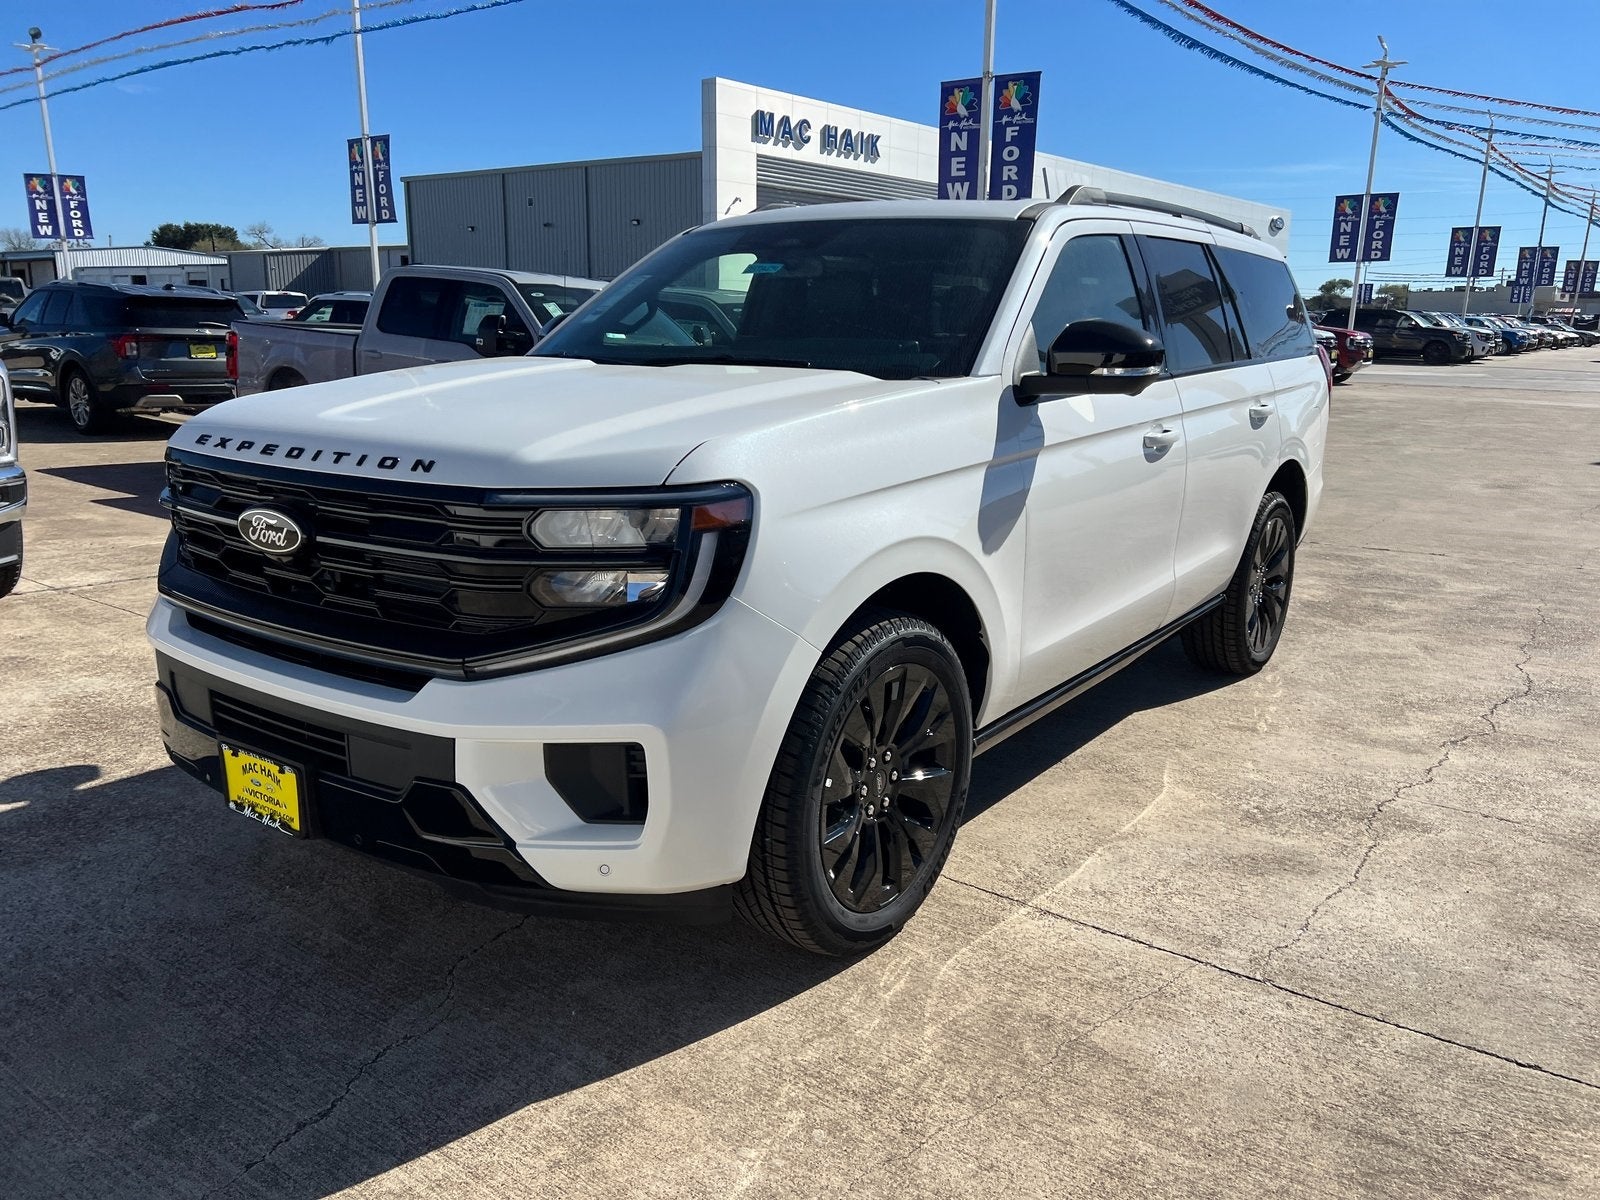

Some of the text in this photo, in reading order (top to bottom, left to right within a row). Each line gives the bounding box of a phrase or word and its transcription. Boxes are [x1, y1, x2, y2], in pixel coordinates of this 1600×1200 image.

[754, 109, 881, 162] MAC HAIK
[947, 131, 970, 200] NEW
[1001, 126, 1020, 200] FORD
[354, 171, 367, 219] NEW
[378, 171, 390, 220] FORD
[35, 199, 53, 236] NEW
[69, 200, 85, 237] FORD
[1335, 221, 1352, 259] NEW
[1370, 220, 1385, 259] FORD
[1451, 247, 1464, 275] NEW
[1478, 246, 1490, 275] FORD
[1519, 262, 1530, 285] NEW
[1541, 262, 1551, 285] FORD
[1565, 272, 1575, 292] NEW
[1583, 273, 1592, 292] FORD
[195, 433, 437, 473] EXPEDITION
[249, 514, 288, 547] Ford
[242, 762, 282, 790] MAC HAIK
[243, 805, 259, 818] Mac
